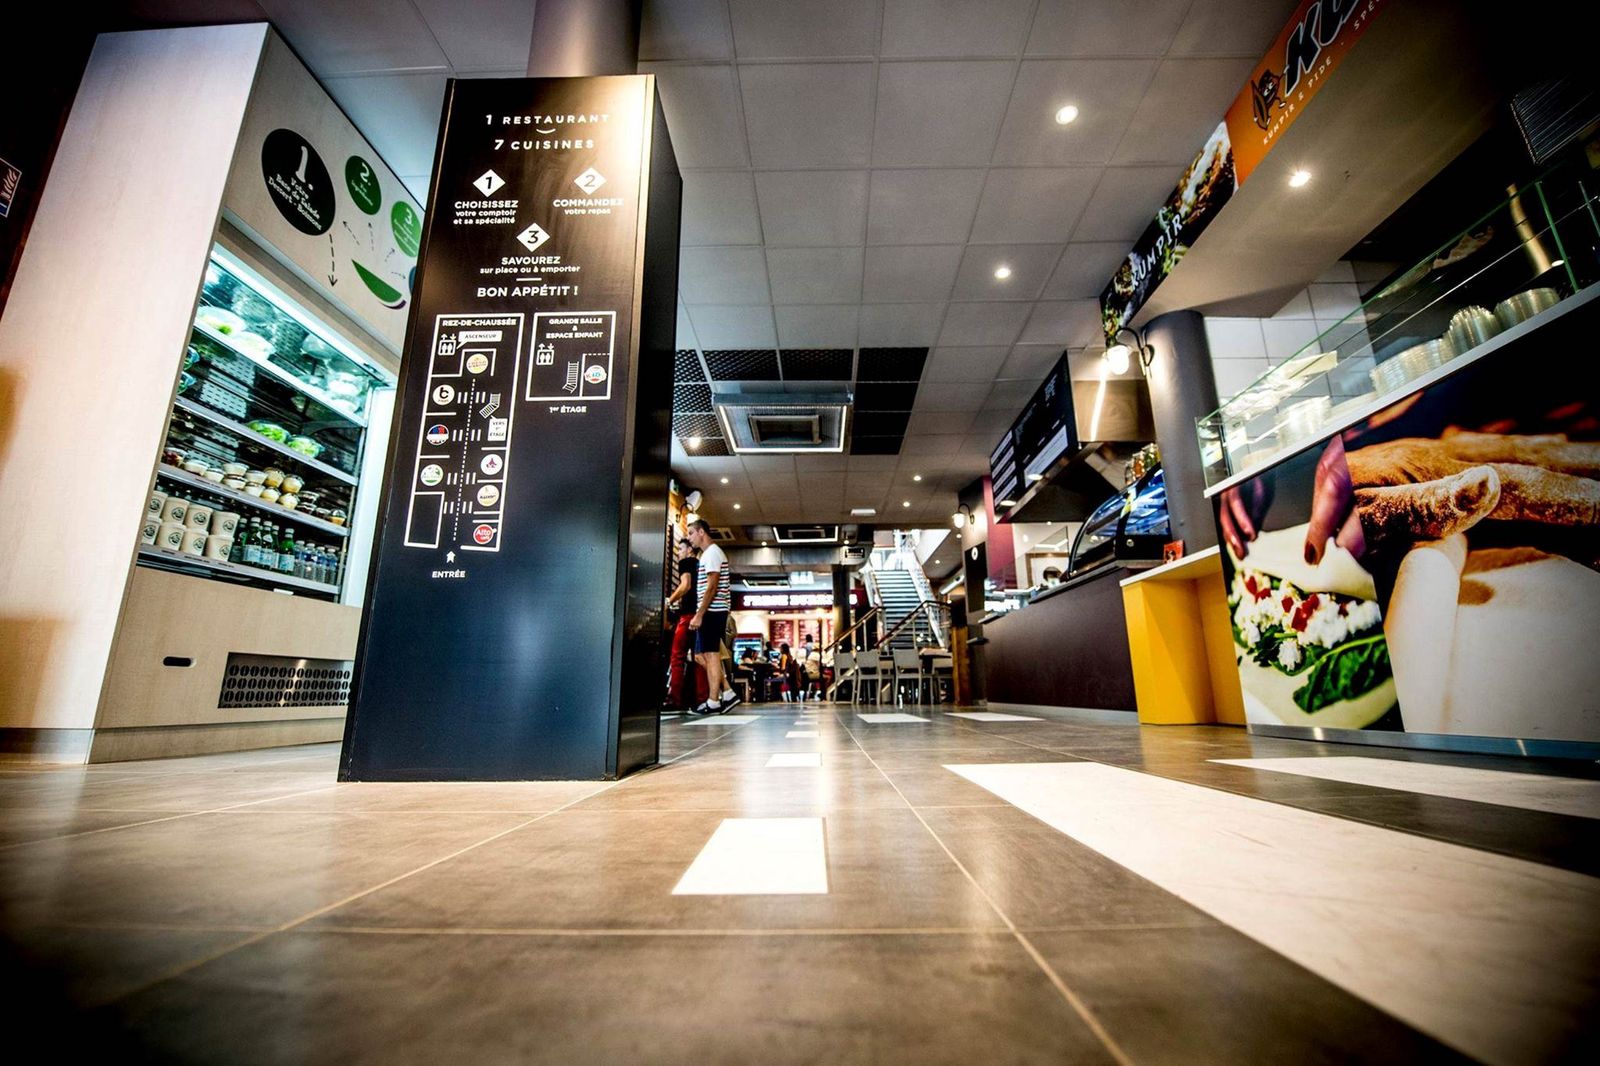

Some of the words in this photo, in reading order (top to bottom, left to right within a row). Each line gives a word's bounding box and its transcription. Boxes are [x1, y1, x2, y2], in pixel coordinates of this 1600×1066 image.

[1263, 104, 1294, 145] KUMPIR
[1307, 56, 1332, 88] PIDE
[485, 114, 493, 126] 1
[502, 114, 610, 126] RESTAURANT
[494, 139, 504, 150] 7
[510, 139, 594, 150] CUISINES
[485, 176, 493, 190] 1
[584, 174, 596, 187] 2
[268, 175, 292, 204] Dessert
[291, 177, 309, 200] Votre
[301, 197, 320, 219] Salade
[454, 200, 519, 209] CHOISISSEZ
[478, 209, 517, 217] comptoir
[475, 217, 515, 225] spécialité
[527, 230, 539, 244] 3
[1131, 214, 1183, 291] KUMPIR
[501, 256, 561, 265] SAVOUREZ
[495, 266, 518, 275] place
[533, 265, 539, 273] à
[540, 265, 580, 274] emporter
[477, 287, 508, 297] BON
[511, 284, 570, 297] APPÉTIT
[573, 286, 579, 296] !
[442, 317, 517, 327] REZ-DE-CHAUSSÉE
[560, 405, 587, 413] ÉTAGE
[431, 569, 466, 578] ENTRÉE
